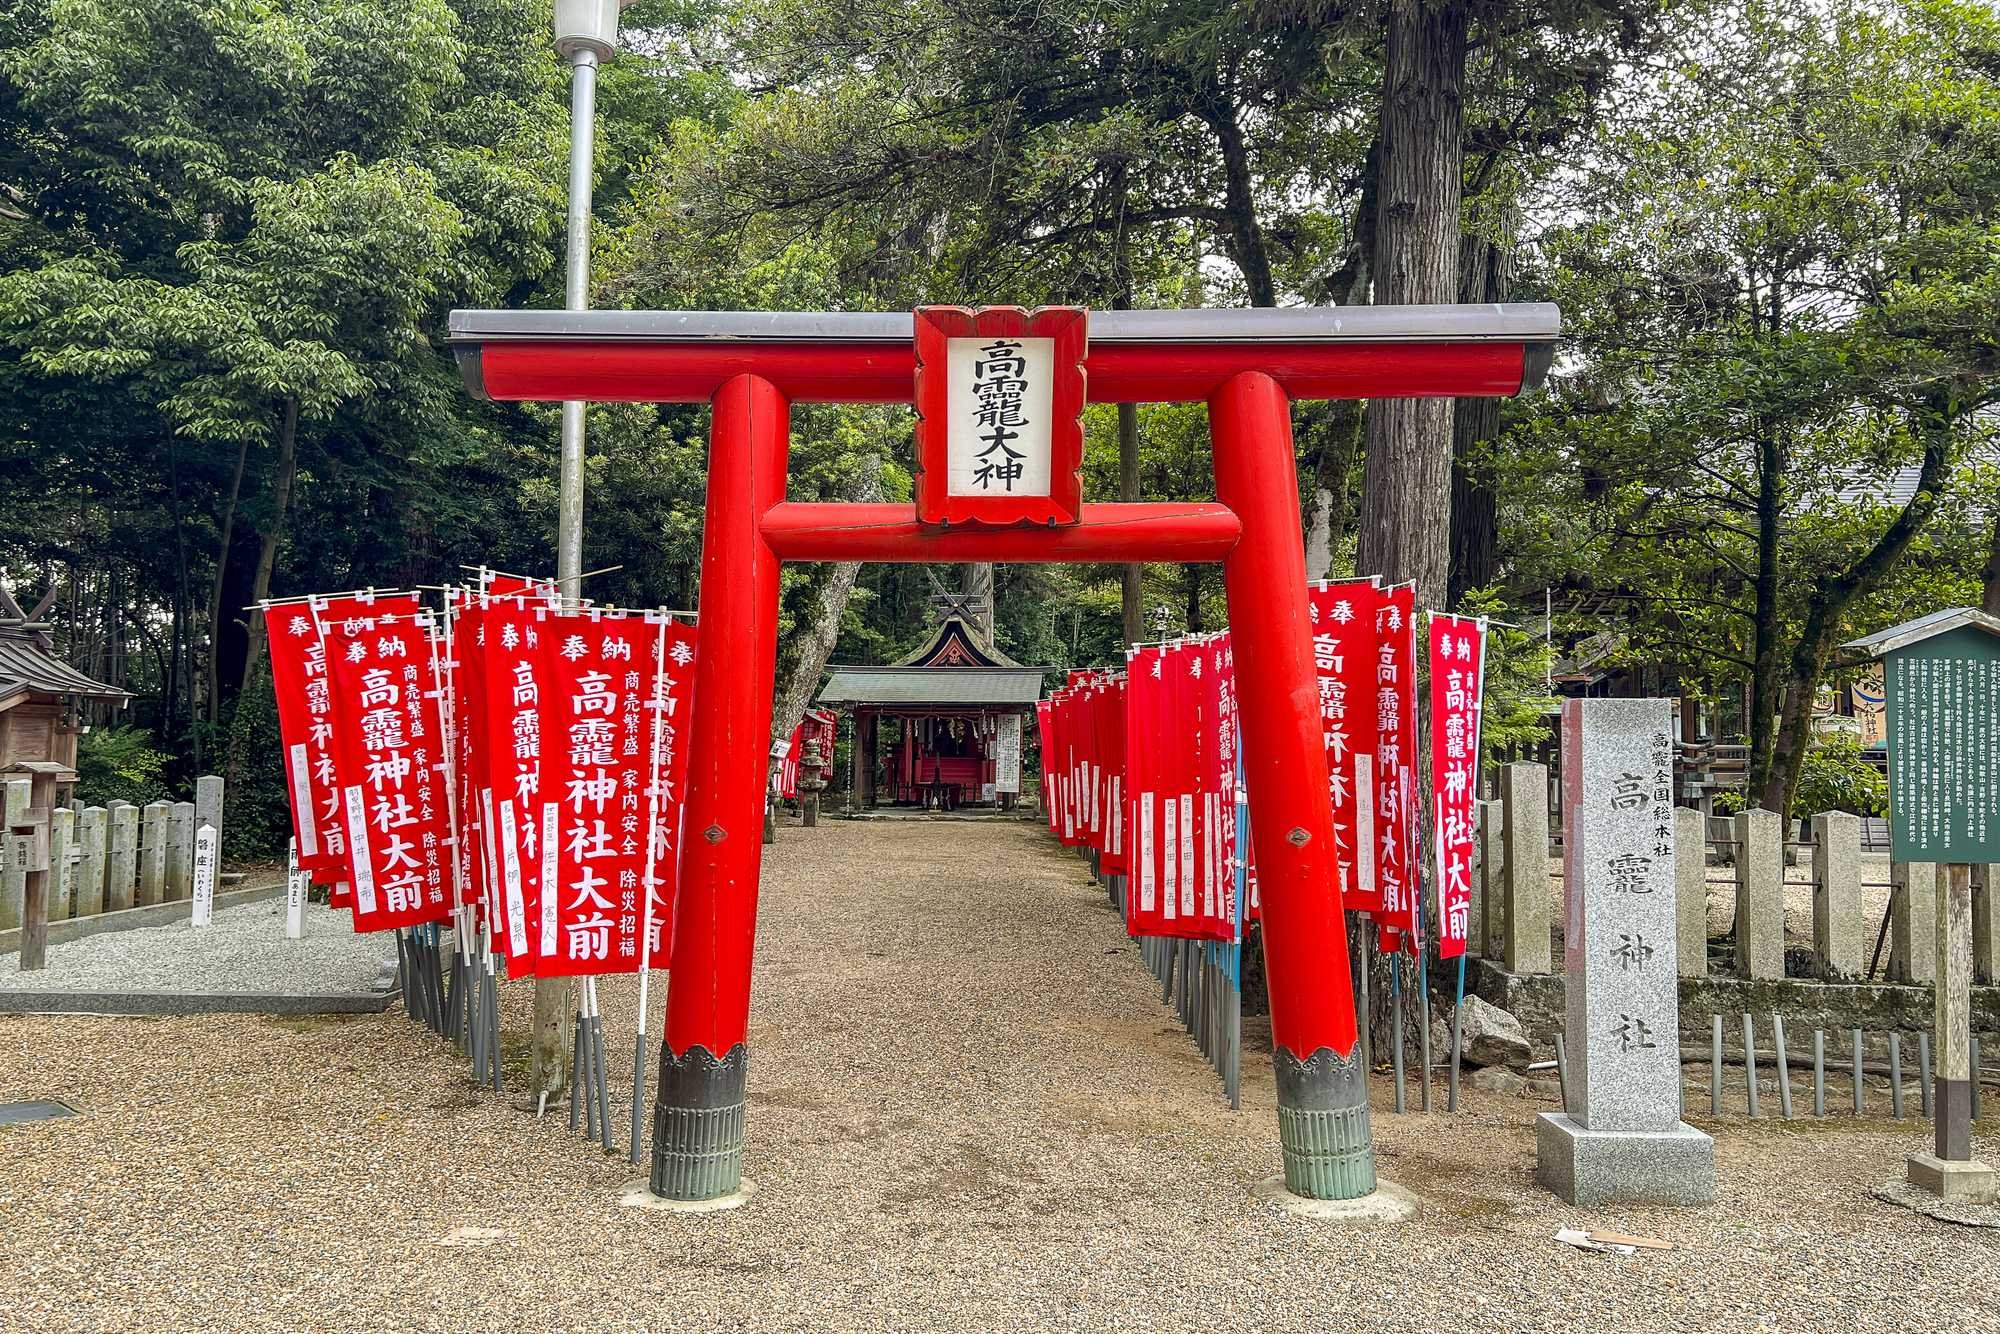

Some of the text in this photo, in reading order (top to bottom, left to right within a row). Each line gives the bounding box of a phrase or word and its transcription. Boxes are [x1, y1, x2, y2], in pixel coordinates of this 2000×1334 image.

[345, 636, 407, 663] 奉納
[560, 635, 631, 662] 奉納
[1440, 633, 1471, 663] 奉納
[360, 668, 424, 914] 高龗神社大前
[402, 664, 443, 903] 商売繁盛 家内安全 除災招福
[564, 670, 620, 961] 高龗神社大前
[618, 671, 641, 958] 商売繁盛 家内安全 除災招福
[1606, 772, 1657, 1051] 高龗神社
